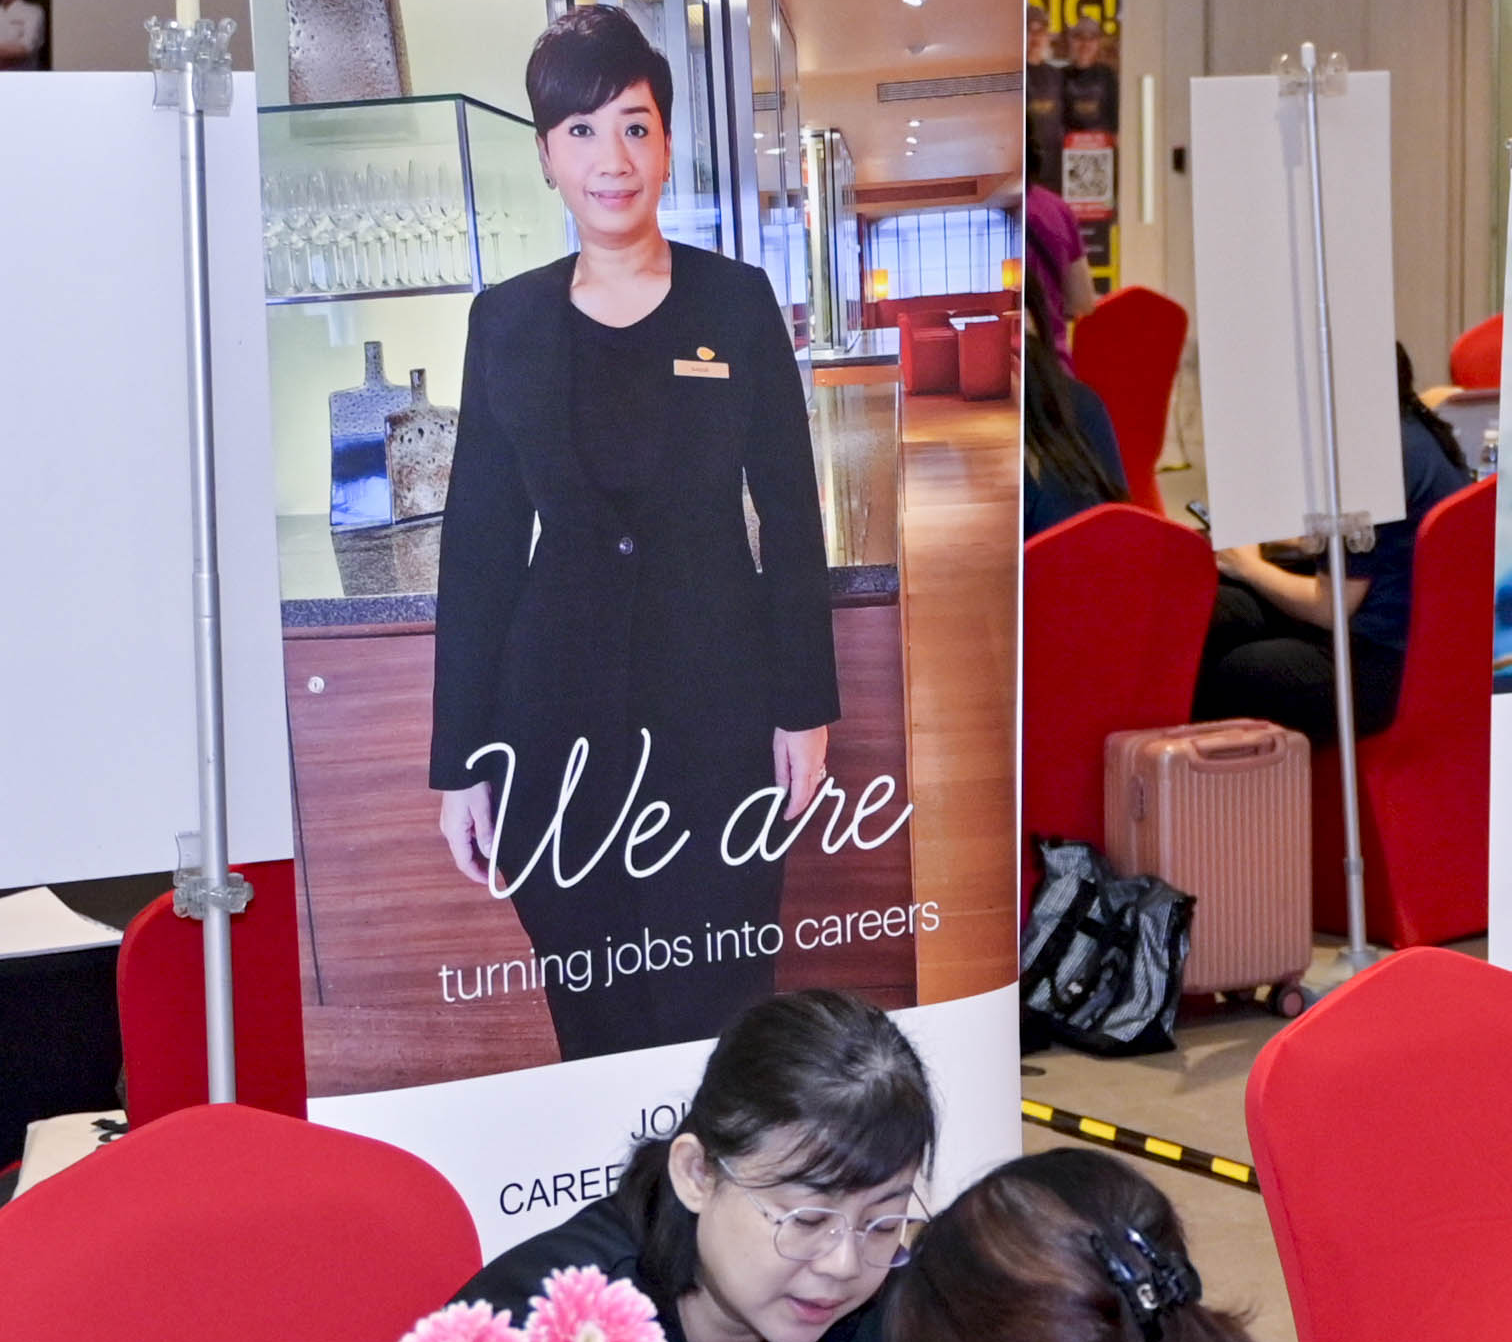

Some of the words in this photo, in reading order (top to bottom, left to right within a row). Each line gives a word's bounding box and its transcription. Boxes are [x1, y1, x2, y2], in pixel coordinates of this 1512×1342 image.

[464, 728, 690, 901] We
[719, 773, 915, 869] are
[438, 945, 593, 1005] turning
[605, 927, 694, 988] jobs
[705, 921, 784, 963] into
[794, 898, 941, 952] careers
